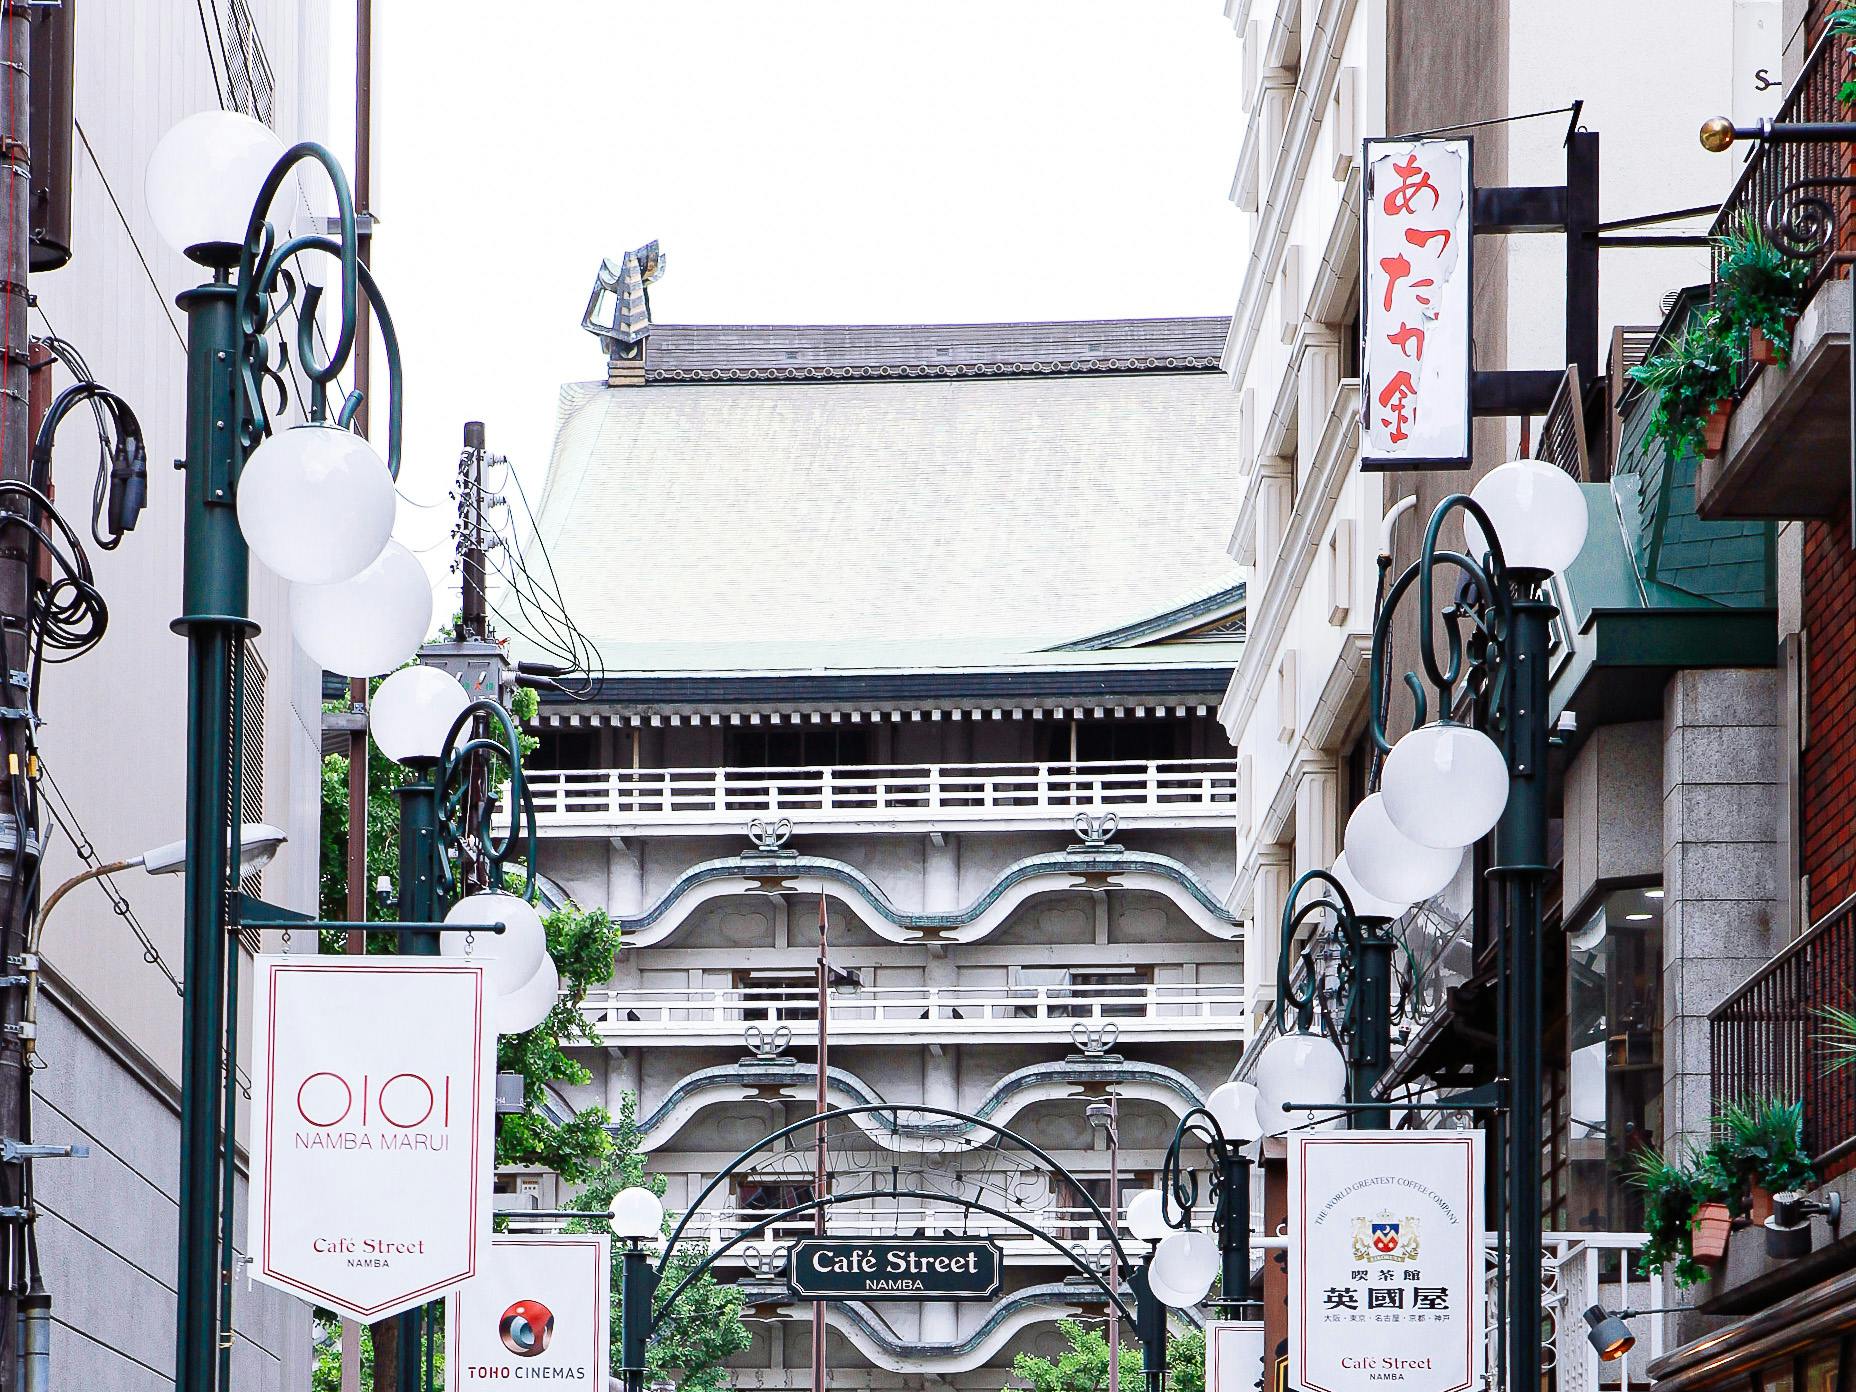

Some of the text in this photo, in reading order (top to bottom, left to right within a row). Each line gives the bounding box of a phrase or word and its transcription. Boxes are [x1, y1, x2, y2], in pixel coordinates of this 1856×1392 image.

[295, 1132, 449, 1151] NAMBA MARUI
[1314, 1177, 1460, 1225] THE WORLD GREATEST COFFEE COMPANY
[313, 1237, 425, 1254] Café Street
[347, 1259, 390, 1268] NAMBA
[812, 1250, 978, 1273] Café Street
[1351, 1269, 1421, 1281] 喫茶館
[865, 1279, 924, 1290] NAMBA
[1323, 1286, 1450, 1310] 英國屋
[1341, 1357, 1432, 1370] Café Street
[468, 1367, 585, 1380] TOHO CINEMAS
[1369, 1373, 1405, 1381] NAMBA
